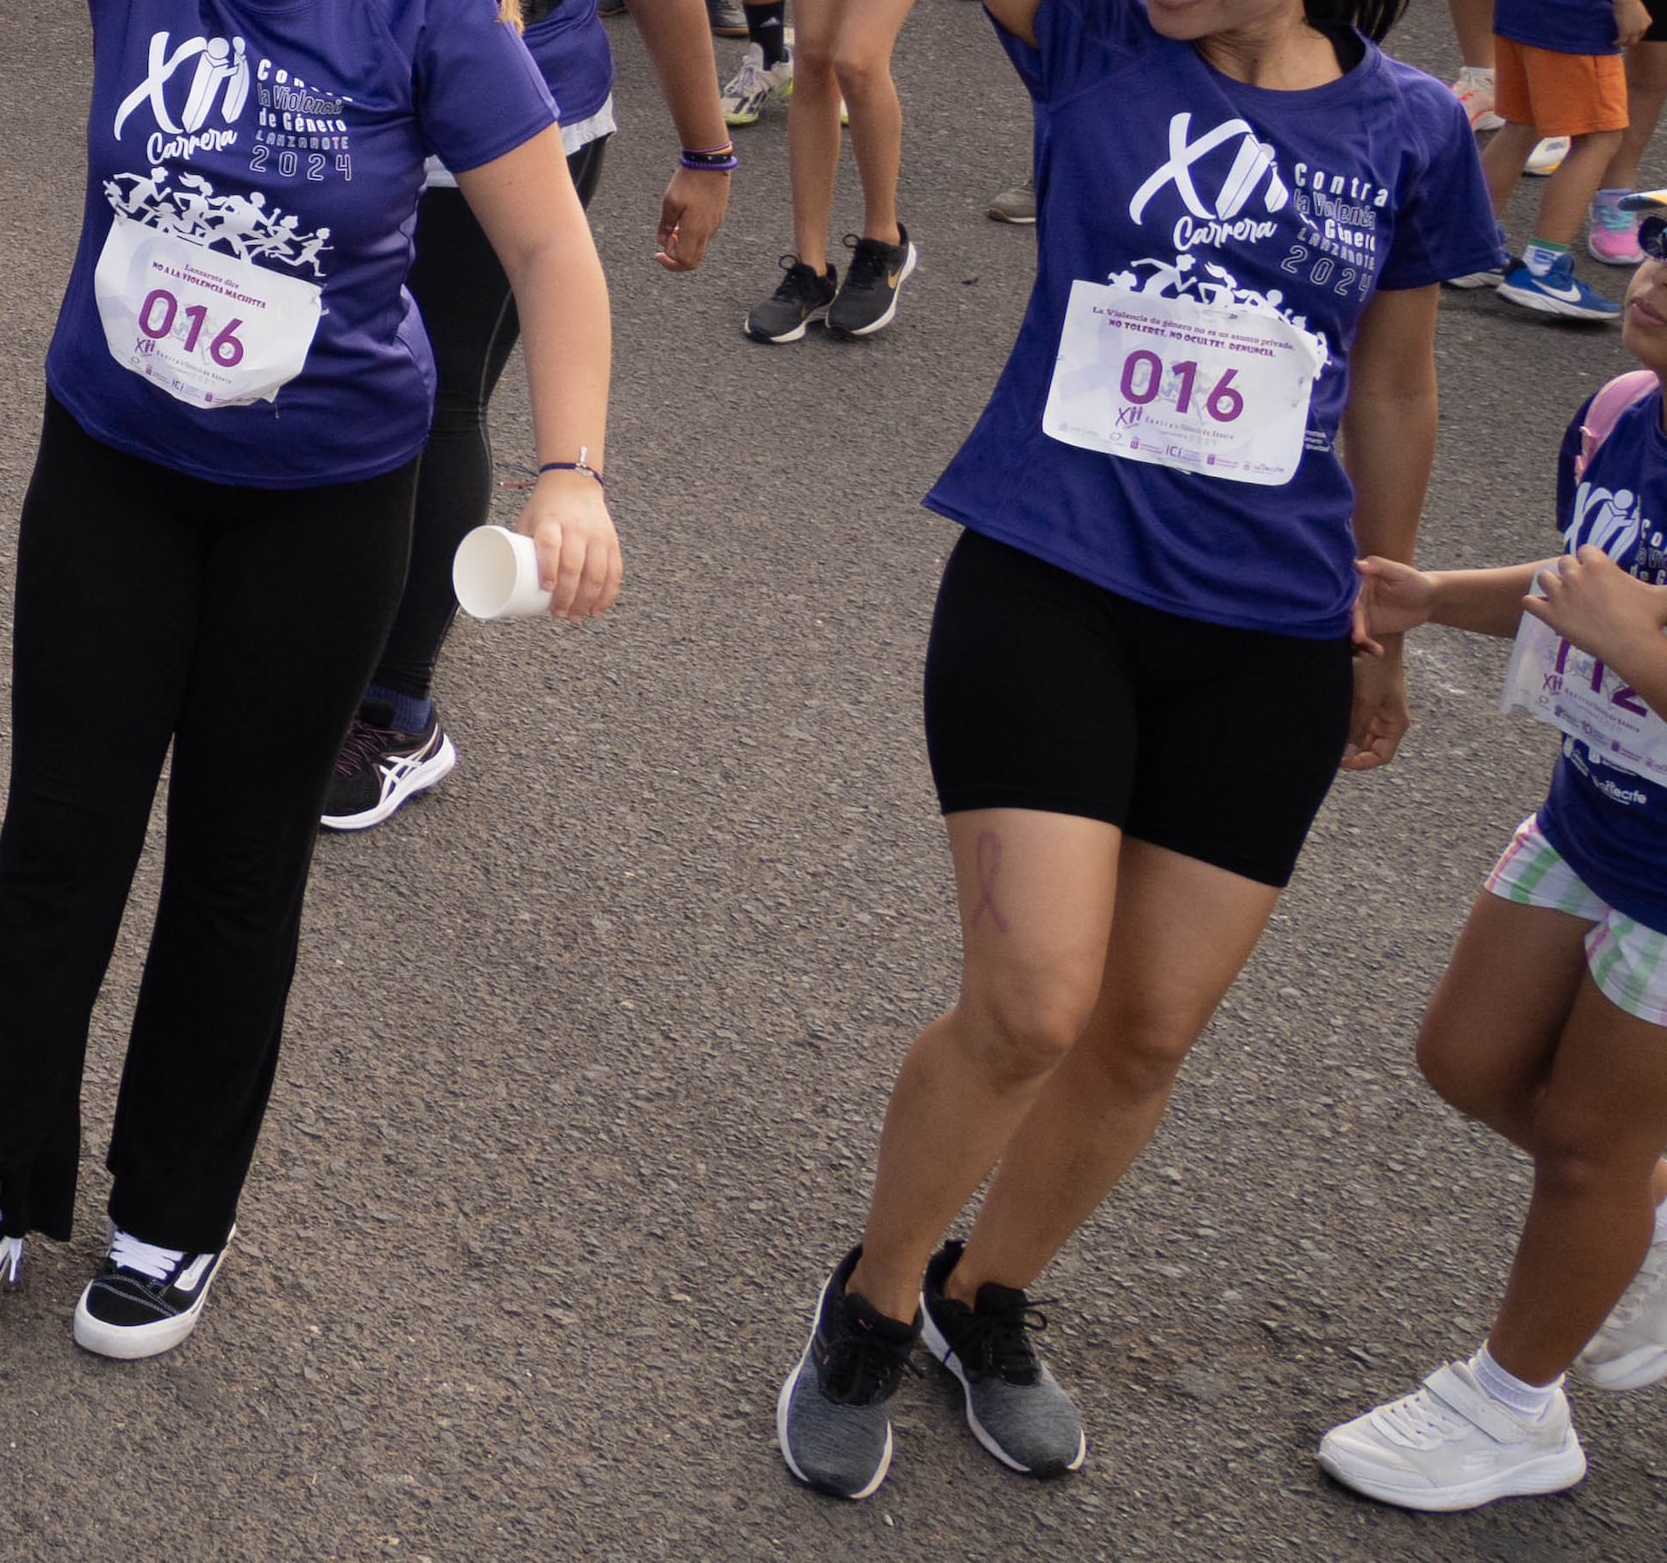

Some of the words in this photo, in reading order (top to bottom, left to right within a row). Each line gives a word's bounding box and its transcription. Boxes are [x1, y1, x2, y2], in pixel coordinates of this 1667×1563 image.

[260, 108, 276, 128] de
[282, 114, 347, 133] Género
[146, 128, 237, 165] Carrera
[255, 130, 349, 151] LANZAROTE
[249, 145, 352, 181] 2024
[1294, 162, 1389, 207] Contra
[1173, 215, 1277, 251] Carrera
[152, 262, 163, 270] NO
[171, 268, 180, 278] LA
[183, 273, 223, 294] VIOLENCIA
[224, 289, 266, 309] MACHISTA
[185, 264, 223, 283] Lanzarote
[224, 279, 239, 289] dice
[138, 289, 244, 368] 016
[1092, 306, 1103, 314] La
[1107, 308, 1148, 322] Violencia
[1150, 317, 1160, 325] de
[1162, 319, 1192, 331] género
[1194, 326, 1205, 334] no
[1109, 319, 1122, 328] NO
[1169, 331, 1182, 340] NO
[1120, 349, 1244, 423] 016
